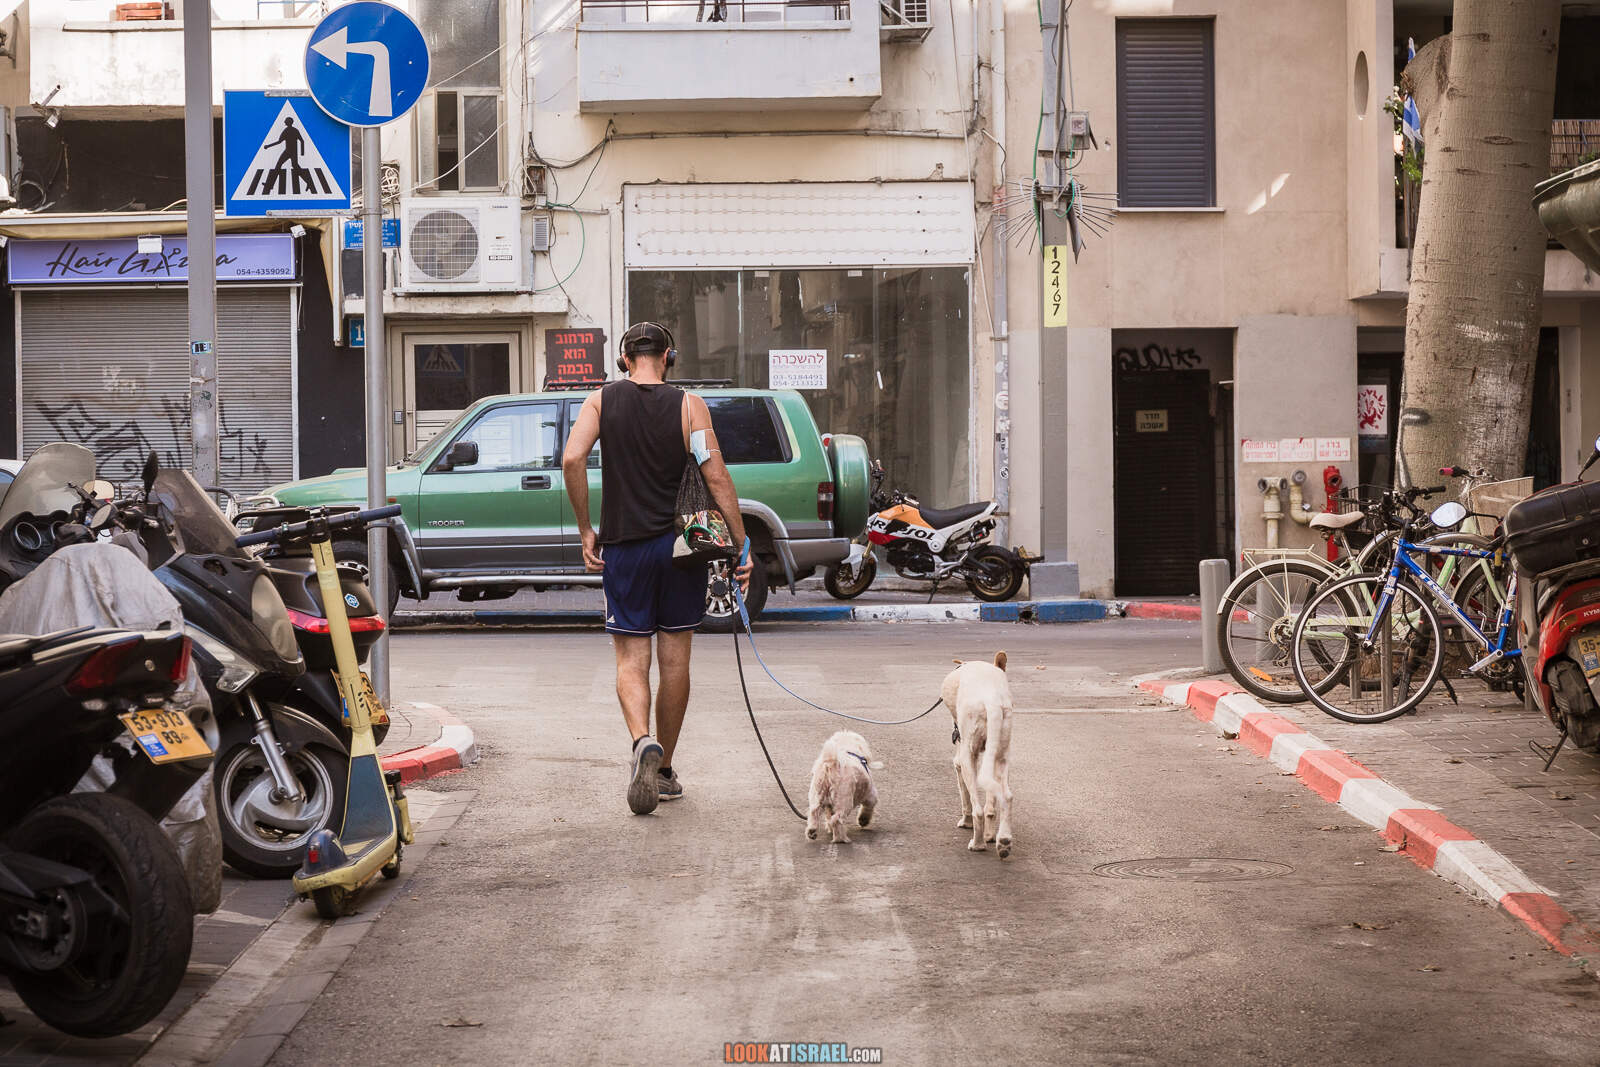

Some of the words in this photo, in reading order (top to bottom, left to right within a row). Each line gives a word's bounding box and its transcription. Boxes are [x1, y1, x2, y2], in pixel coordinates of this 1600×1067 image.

[45, 241, 120, 276] Hair
[236, 267, 290, 276] 054-4359092
[1051, 246, 1062, 316] 12467
[555, 333, 594, 344] הרחוב
[564, 348, 586, 360] הוא
[772, 353, 825, 365] להשכרה
[557, 363, 593, 375] הבמה
